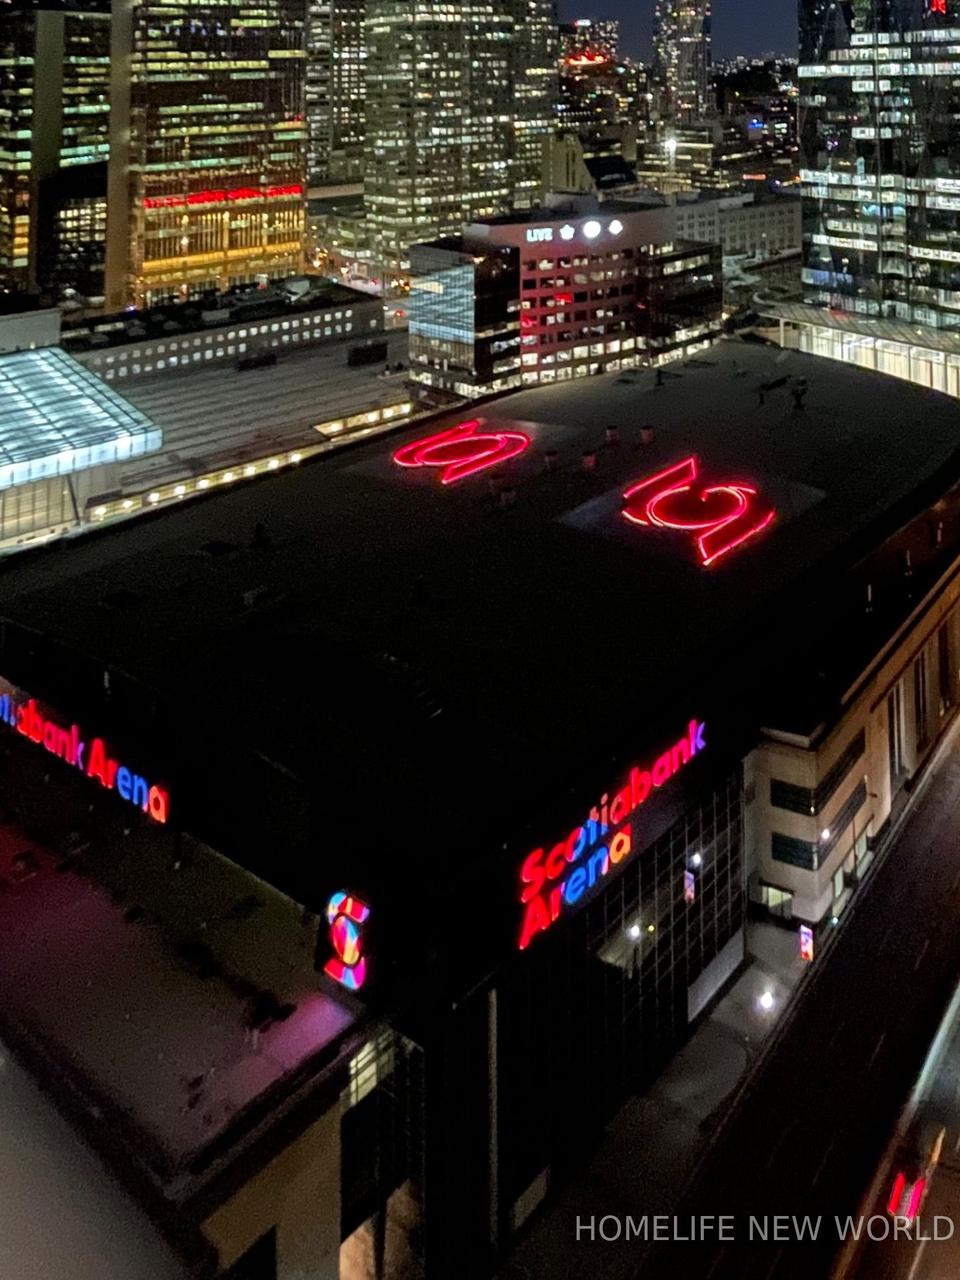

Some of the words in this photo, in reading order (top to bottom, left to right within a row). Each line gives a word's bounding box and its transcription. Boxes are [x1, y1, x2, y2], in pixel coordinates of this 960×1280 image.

[88, 738, 168, 823] Arena
[521, 720, 706, 902] Scotiabank
[519, 824, 632, 950] Arena
